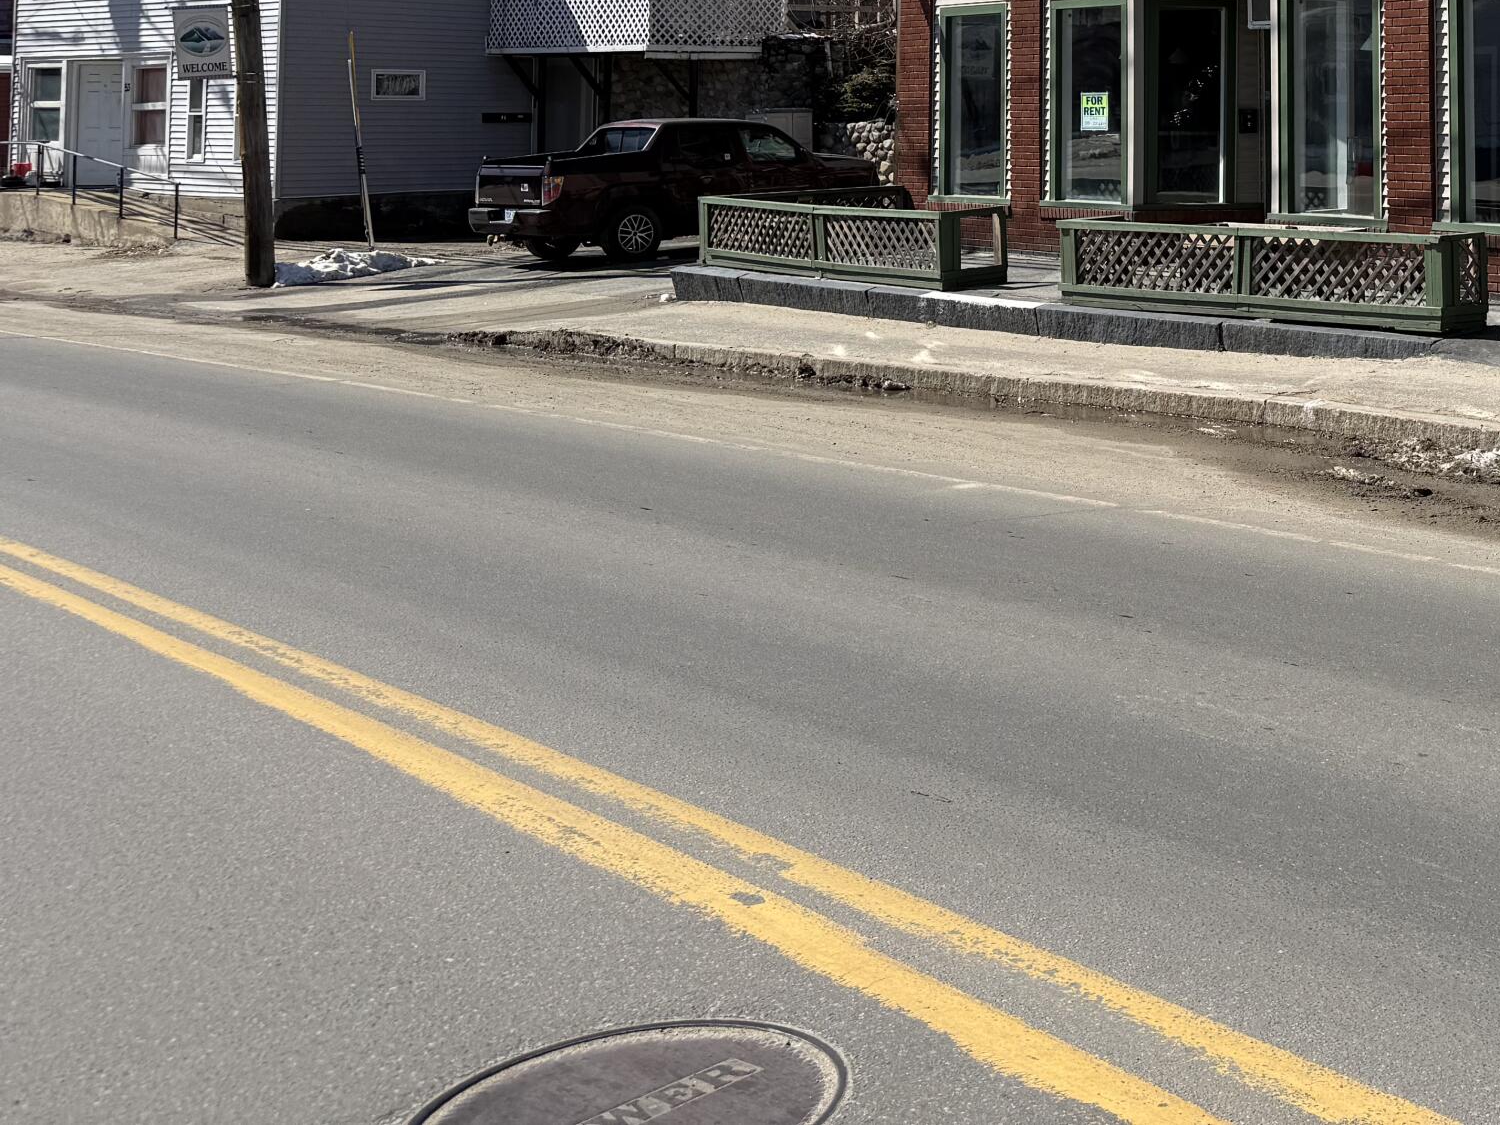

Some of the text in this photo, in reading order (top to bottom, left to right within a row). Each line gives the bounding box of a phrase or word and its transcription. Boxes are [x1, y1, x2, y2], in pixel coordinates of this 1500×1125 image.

[182, 61, 229, 74] WELCOME
[1086, 96, 1103, 106] FOR
[1083, 106, 1106, 116] RENT
